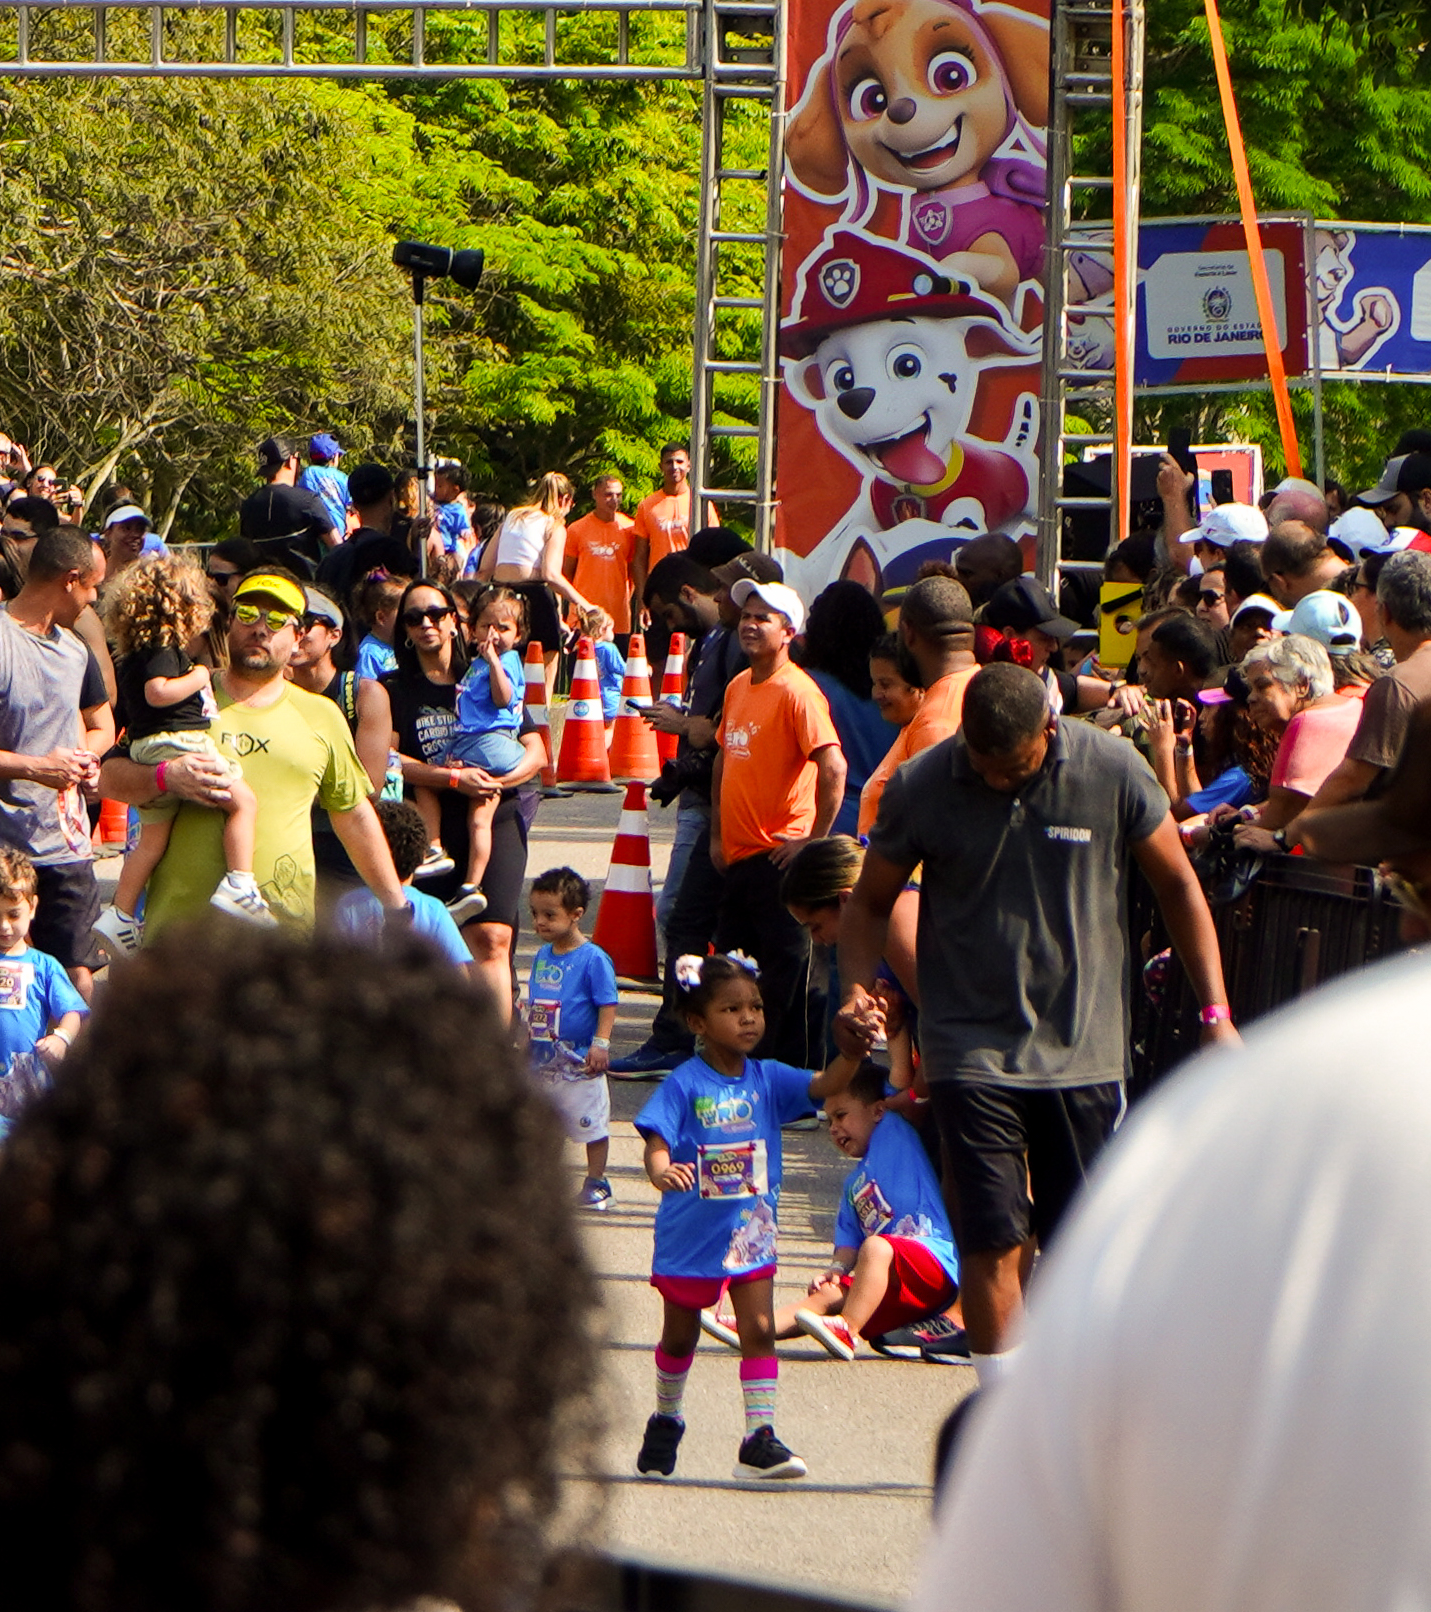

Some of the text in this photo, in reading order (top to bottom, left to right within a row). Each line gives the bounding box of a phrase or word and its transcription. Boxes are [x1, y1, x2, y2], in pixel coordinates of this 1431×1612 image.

[1168, 333, 1191, 345] RIO
[1194, 332, 1211, 344] DE
[1047, 824, 1092, 842] SPIRIDON
[710, 1161, 745, 1175] 0969
